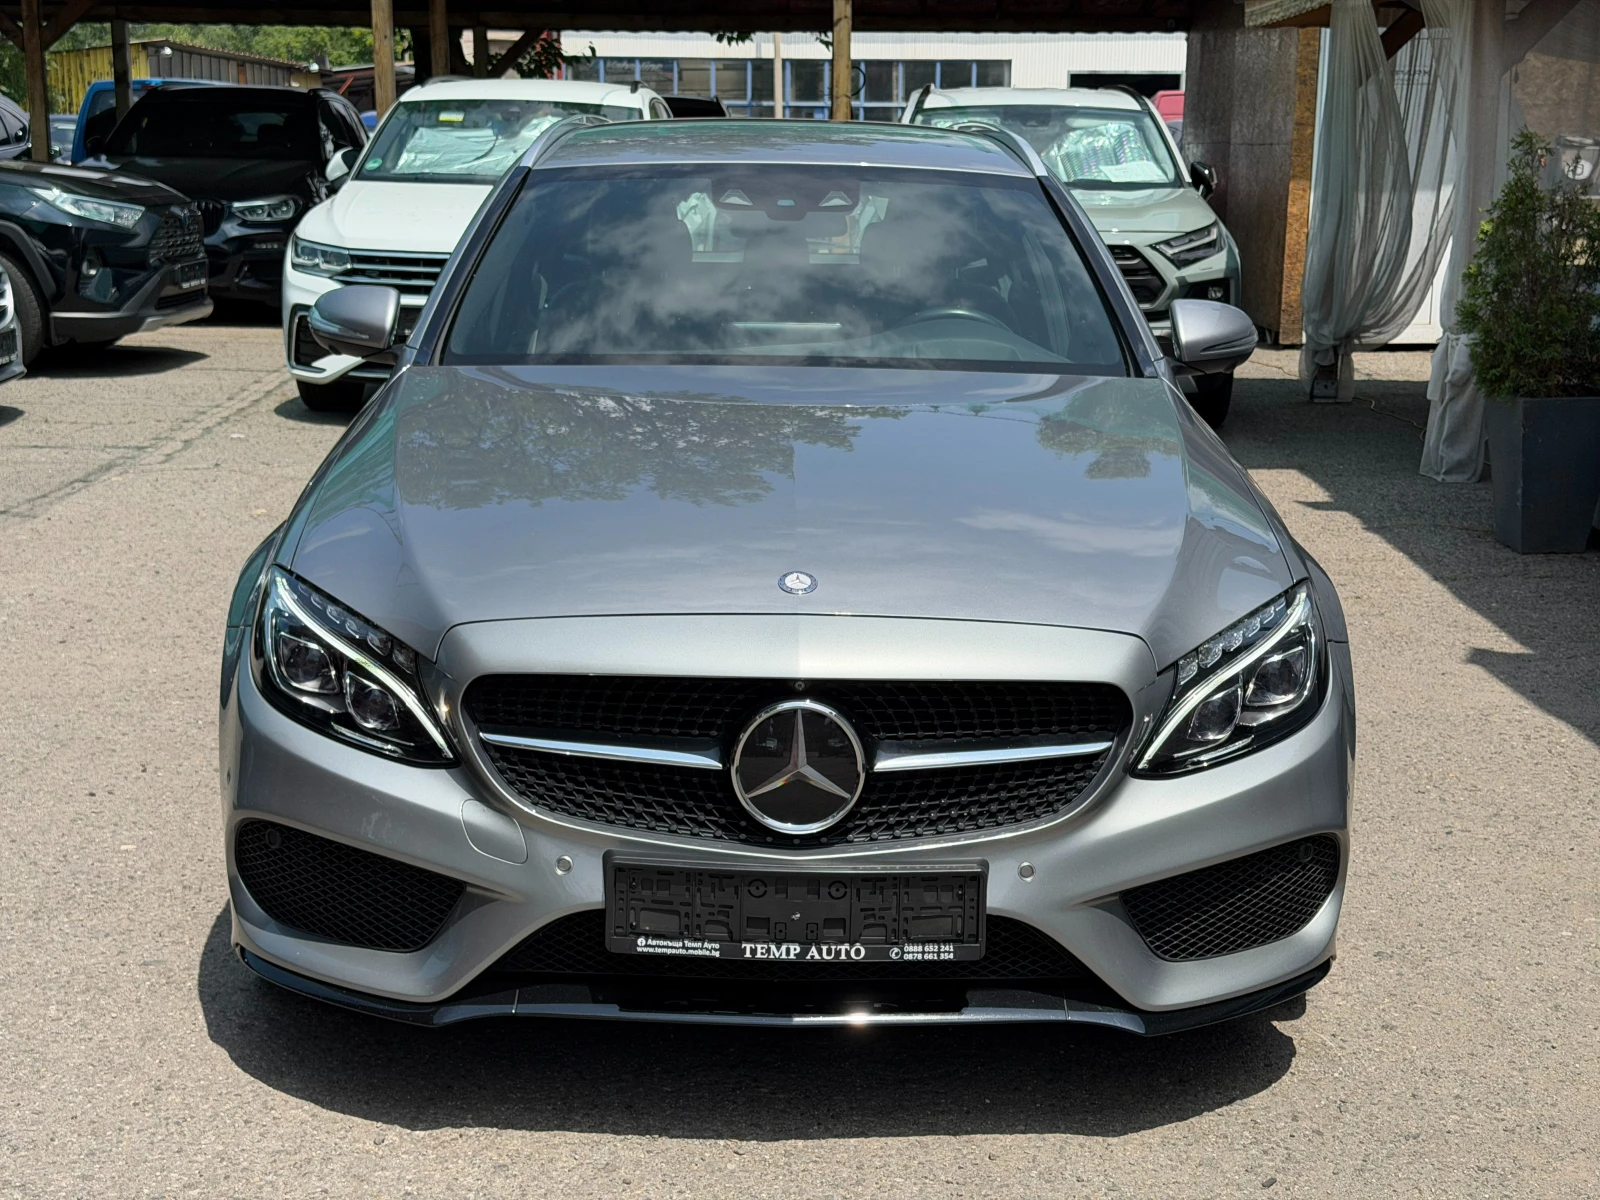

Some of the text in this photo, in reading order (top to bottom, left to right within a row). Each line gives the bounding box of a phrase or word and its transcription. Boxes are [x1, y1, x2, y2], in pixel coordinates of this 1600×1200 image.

[647, 938, 720, 950] Автокъща Темп Ауто
[636, 945, 720, 957] www.tempauto.mobile.bg
[741, 943, 866, 960] TEMP AUTO
[903, 952, 954, 960] 0878 661 354
